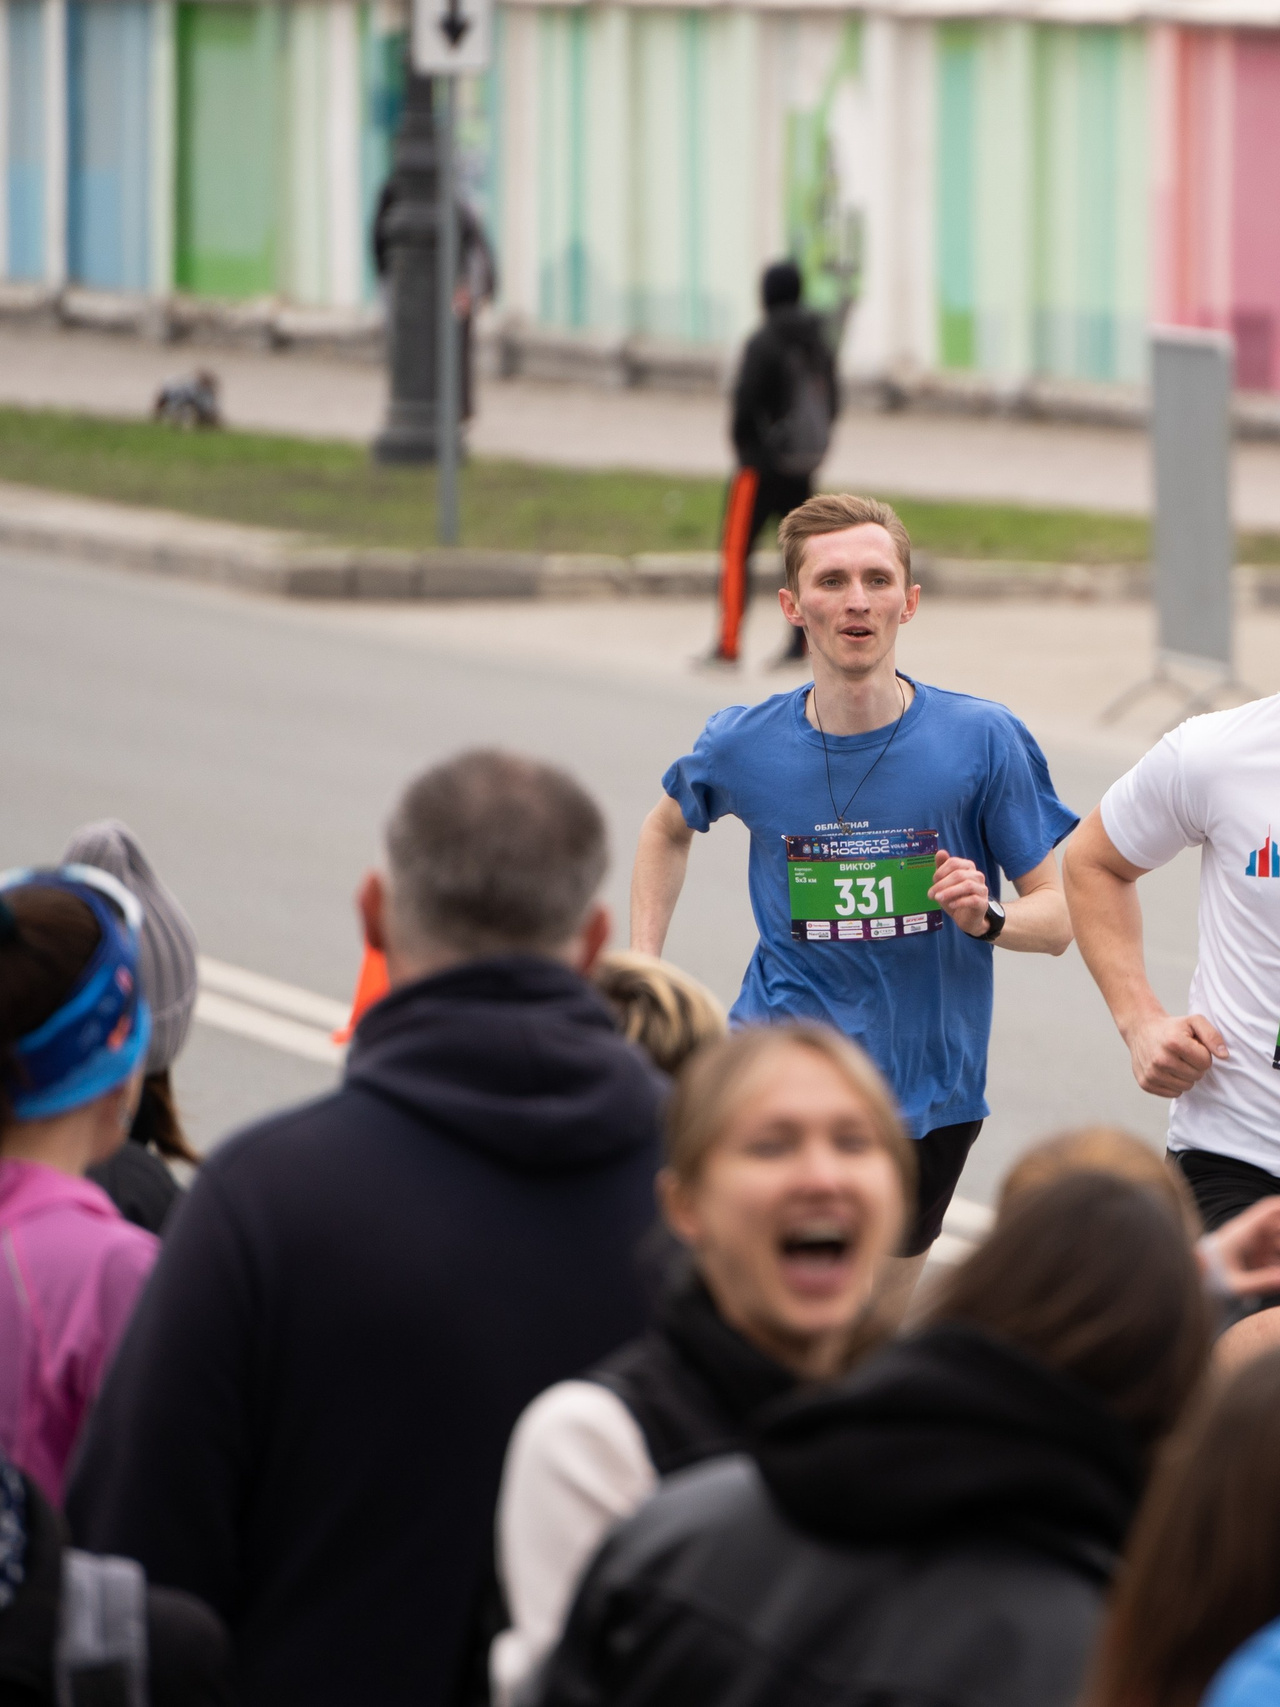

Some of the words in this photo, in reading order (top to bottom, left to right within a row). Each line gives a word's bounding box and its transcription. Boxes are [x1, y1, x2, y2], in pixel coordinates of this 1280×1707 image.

[840, 839, 890, 847] ПРОСТО
[830, 845, 890, 856] КОСМОС
[839, 862, 877, 872] ВИКТОР
[834, 876, 894, 916] 331
